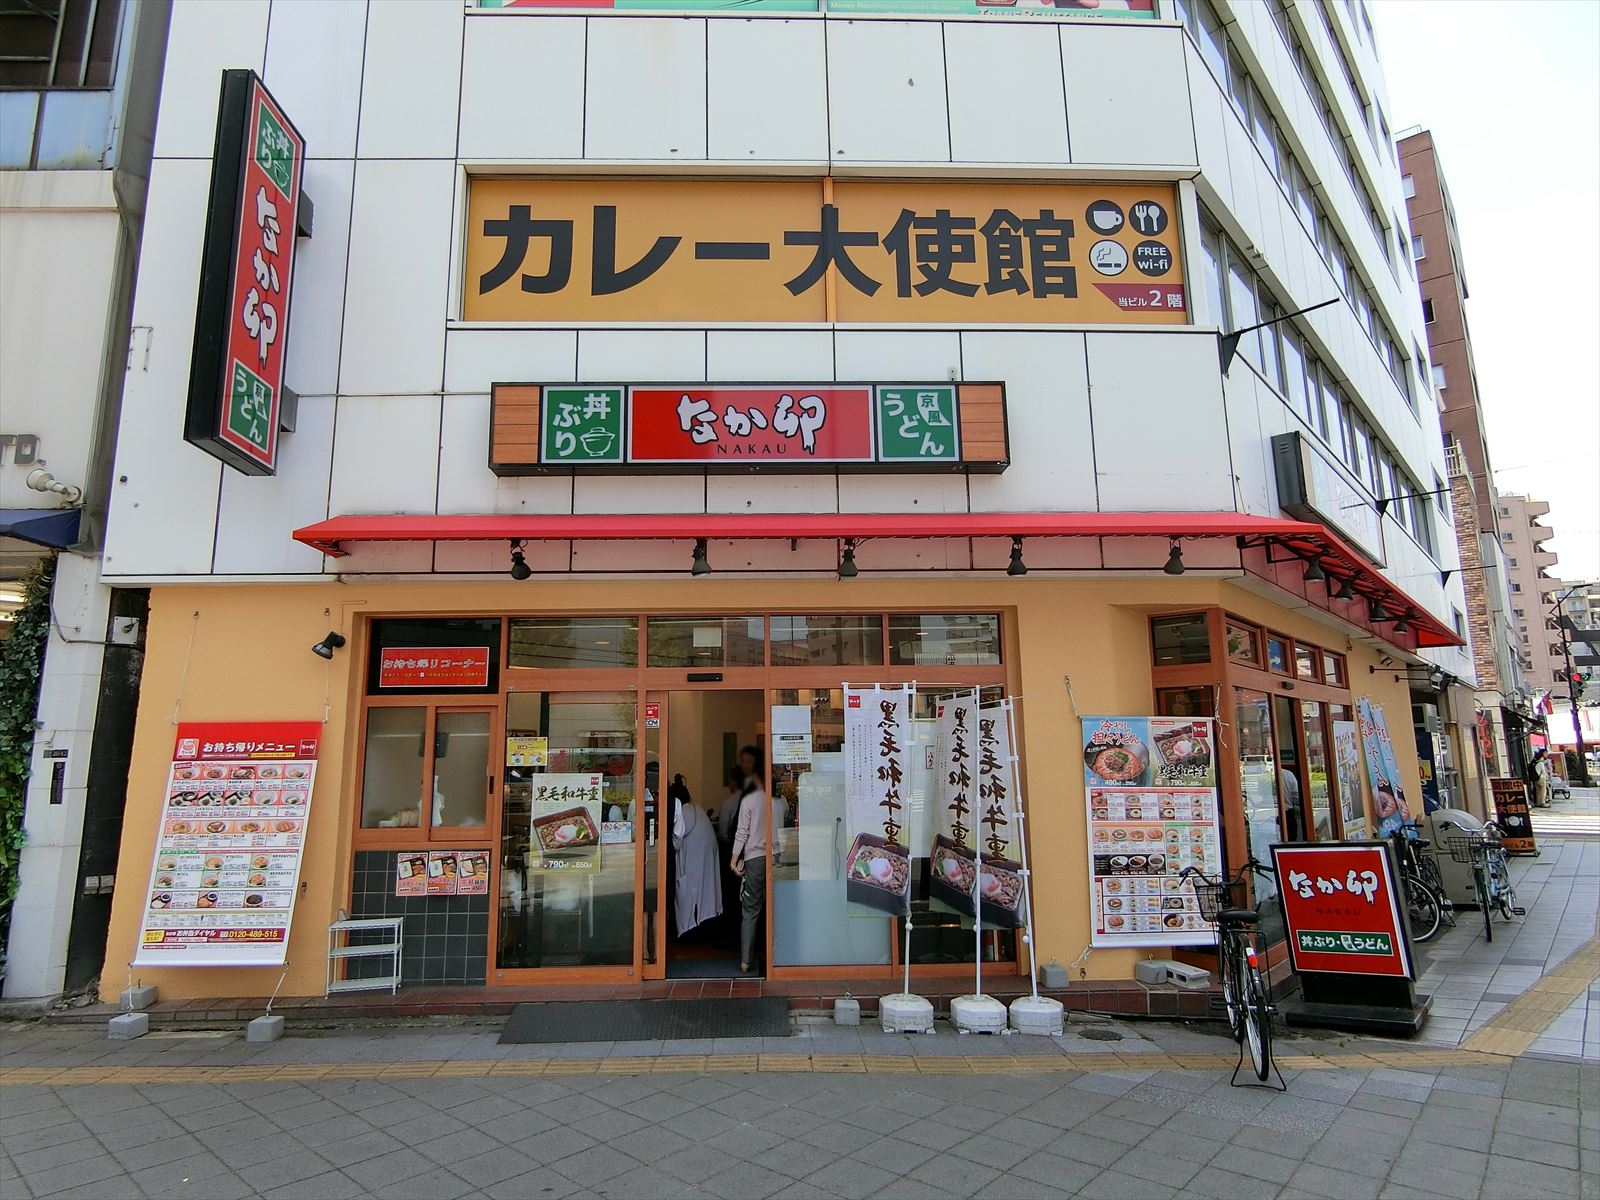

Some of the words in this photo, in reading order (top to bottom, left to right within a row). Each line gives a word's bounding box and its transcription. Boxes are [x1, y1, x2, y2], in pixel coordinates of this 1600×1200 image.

[479, 203, 1078, 299] カレー大使館
[1137, 246, 1167, 256] FREE
[1138, 259, 1168, 270] wi-fi
[243, 184, 282, 370] なか卯
[236, 368, 263, 444] うどん
[920, 394, 942, 423] 京風
[676, 393, 827, 455] なか卯
[883, 393, 945, 456] うどん
[717, 444, 787, 454] NAKAU
[1100, 720, 1131, 732] 冷やし
[202, 742, 296, 753] お持ち帰りメニュー
[535, 785, 600, 802] 黒毛和牛重
[1495, 793, 1524, 803] カレー
[1288, 869, 1378, 905] なか卯
